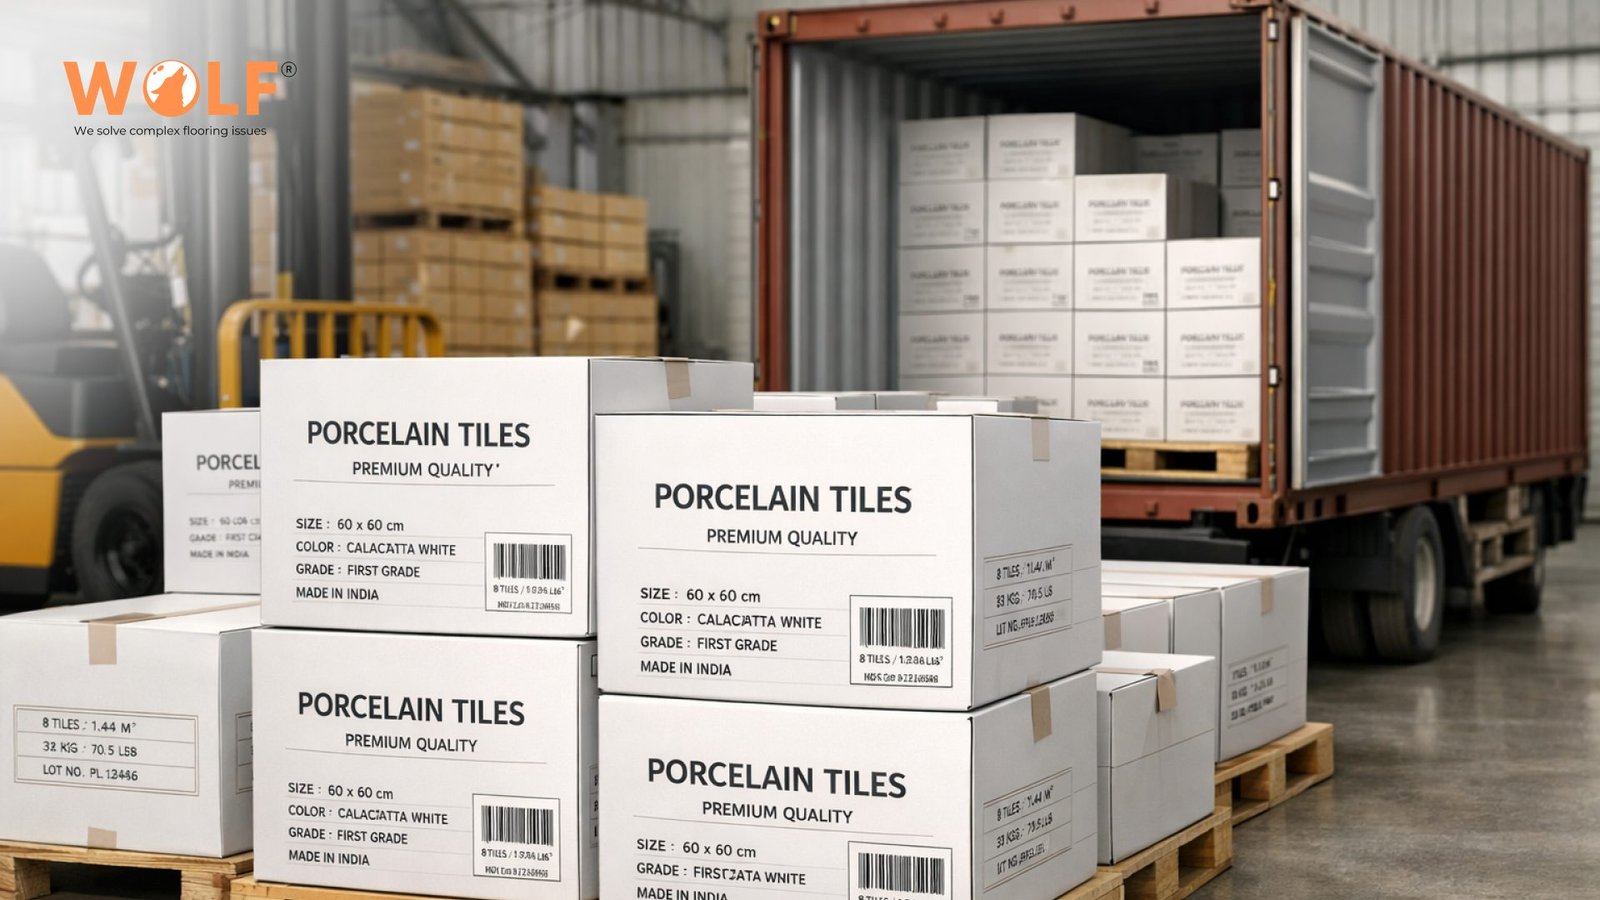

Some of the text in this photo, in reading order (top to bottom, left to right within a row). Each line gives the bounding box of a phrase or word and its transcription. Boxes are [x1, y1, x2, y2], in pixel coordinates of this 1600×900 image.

[308, 421, 530, 448] PORCELAIN TILES
[197, 454, 260, 470] PORCEL
[353, 462, 422, 476] PREMIUM
[656, 483, 911, 513] PORCELAIN TILES
[296, 518, 322, 529] SIZE
[338, 519, 352, 530] 60
[357, 522, 362, 530] x
[367, 519, 382, 530] 60
[387, 523, 403, 531] cm
[708, 529, 858, 547] PREMIUM QUALITY
[296, 541, 334, 552] COLOR
[347, 542, 415, 554] CALACATTA
[419, 544, 455, 555] WHITE
[296, 564, 334, 575] GRADE
[348, 565, 378, 576] FIRST
[382, 566, 420, 577] GRADE
[297, 587, 379, 600] MADE IN INDIA
[641, 588, 670, 599] SIZE
[687, 589, 703, 601] 60
[708, 592, 715, 600] x
[720, 590, 736, 602] 60
[741, 593, 760, 602] cm
[641, 612, 682, 624] COLOR
[641, 636, 683, 648] GRADE
[698, 638, 732, 649] FIRST
[735, 639, 777, 651] GRADE
[859, 654, 865, 663] 8
[641, 661, 731, 676] MADE IN INDIA
[299, 692, 524, 726] PORCELAIN TILES
[43, 717, 49, 728] 8
[52, 718, 79, 730] TILES
[92, 721, 116, 732] 1.44
[346, 734, 477, 752] PREMIUM QUALITY
[43, 765, 62, 775] LOT
[649, 758, 906, 798] PORCELAIN TILES
[289, 783, 314, 794] SIZE
[328, 785, 343, 796] 60
[347, 789, 353, 797] x
[358, 787, 372, 798] 60
[376, 791, 393, 799] cm
[289, 805, 325, 817] COLOR
[412, 812, 448, 824] WHITE
[703, 801, 853, 823] PREMIUM QUALITY
[289, 827, 325, 839] GRADE
[338, 830, 367, 841] FIRST
[370, 832, 407, 844] GRADE
[481, 848, 486, 857] 8
[637, 839, 666, 851] SIZE
[683, 842, 699, 854] 60
[704, 846, 711, 854] x
[716, 844, 732, 856] 60
[737, 848, 756, 857] cm
[289, 850, 370, 866] MADE IN INDIA
[637, 862, 679, 876] GRADE
[637, 887, 672, 900] MADE
[677, 890, 689, 900] IN
